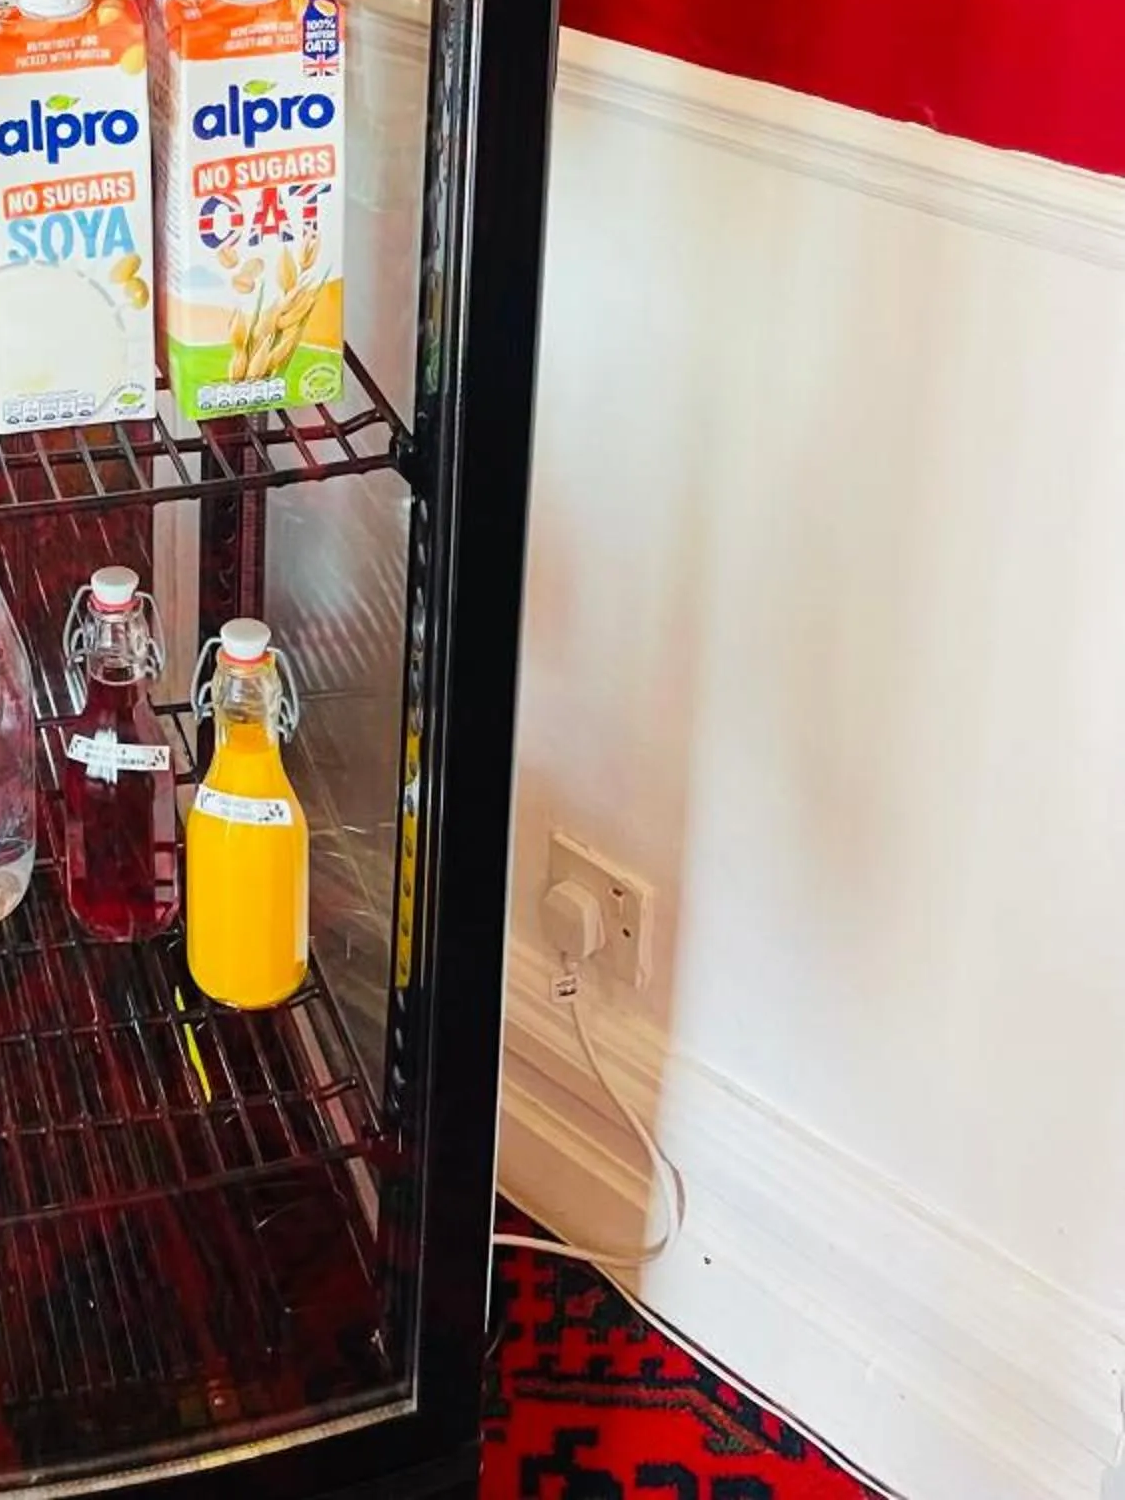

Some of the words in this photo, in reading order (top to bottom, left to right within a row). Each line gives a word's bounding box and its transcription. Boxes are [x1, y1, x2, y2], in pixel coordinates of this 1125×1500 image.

[305, 39, 336, 53] OATS
[192, 84, 335, 148] alpro
[7, 190, 38, 215] NO
[42, 178, 131, 208] SUGARS
[198, 168, 230, 193] NO
[234, 151, 332, 186] SUGARS
[7, 206, 136, 267] SOYA
[198, 184, 332, 250] OAT
